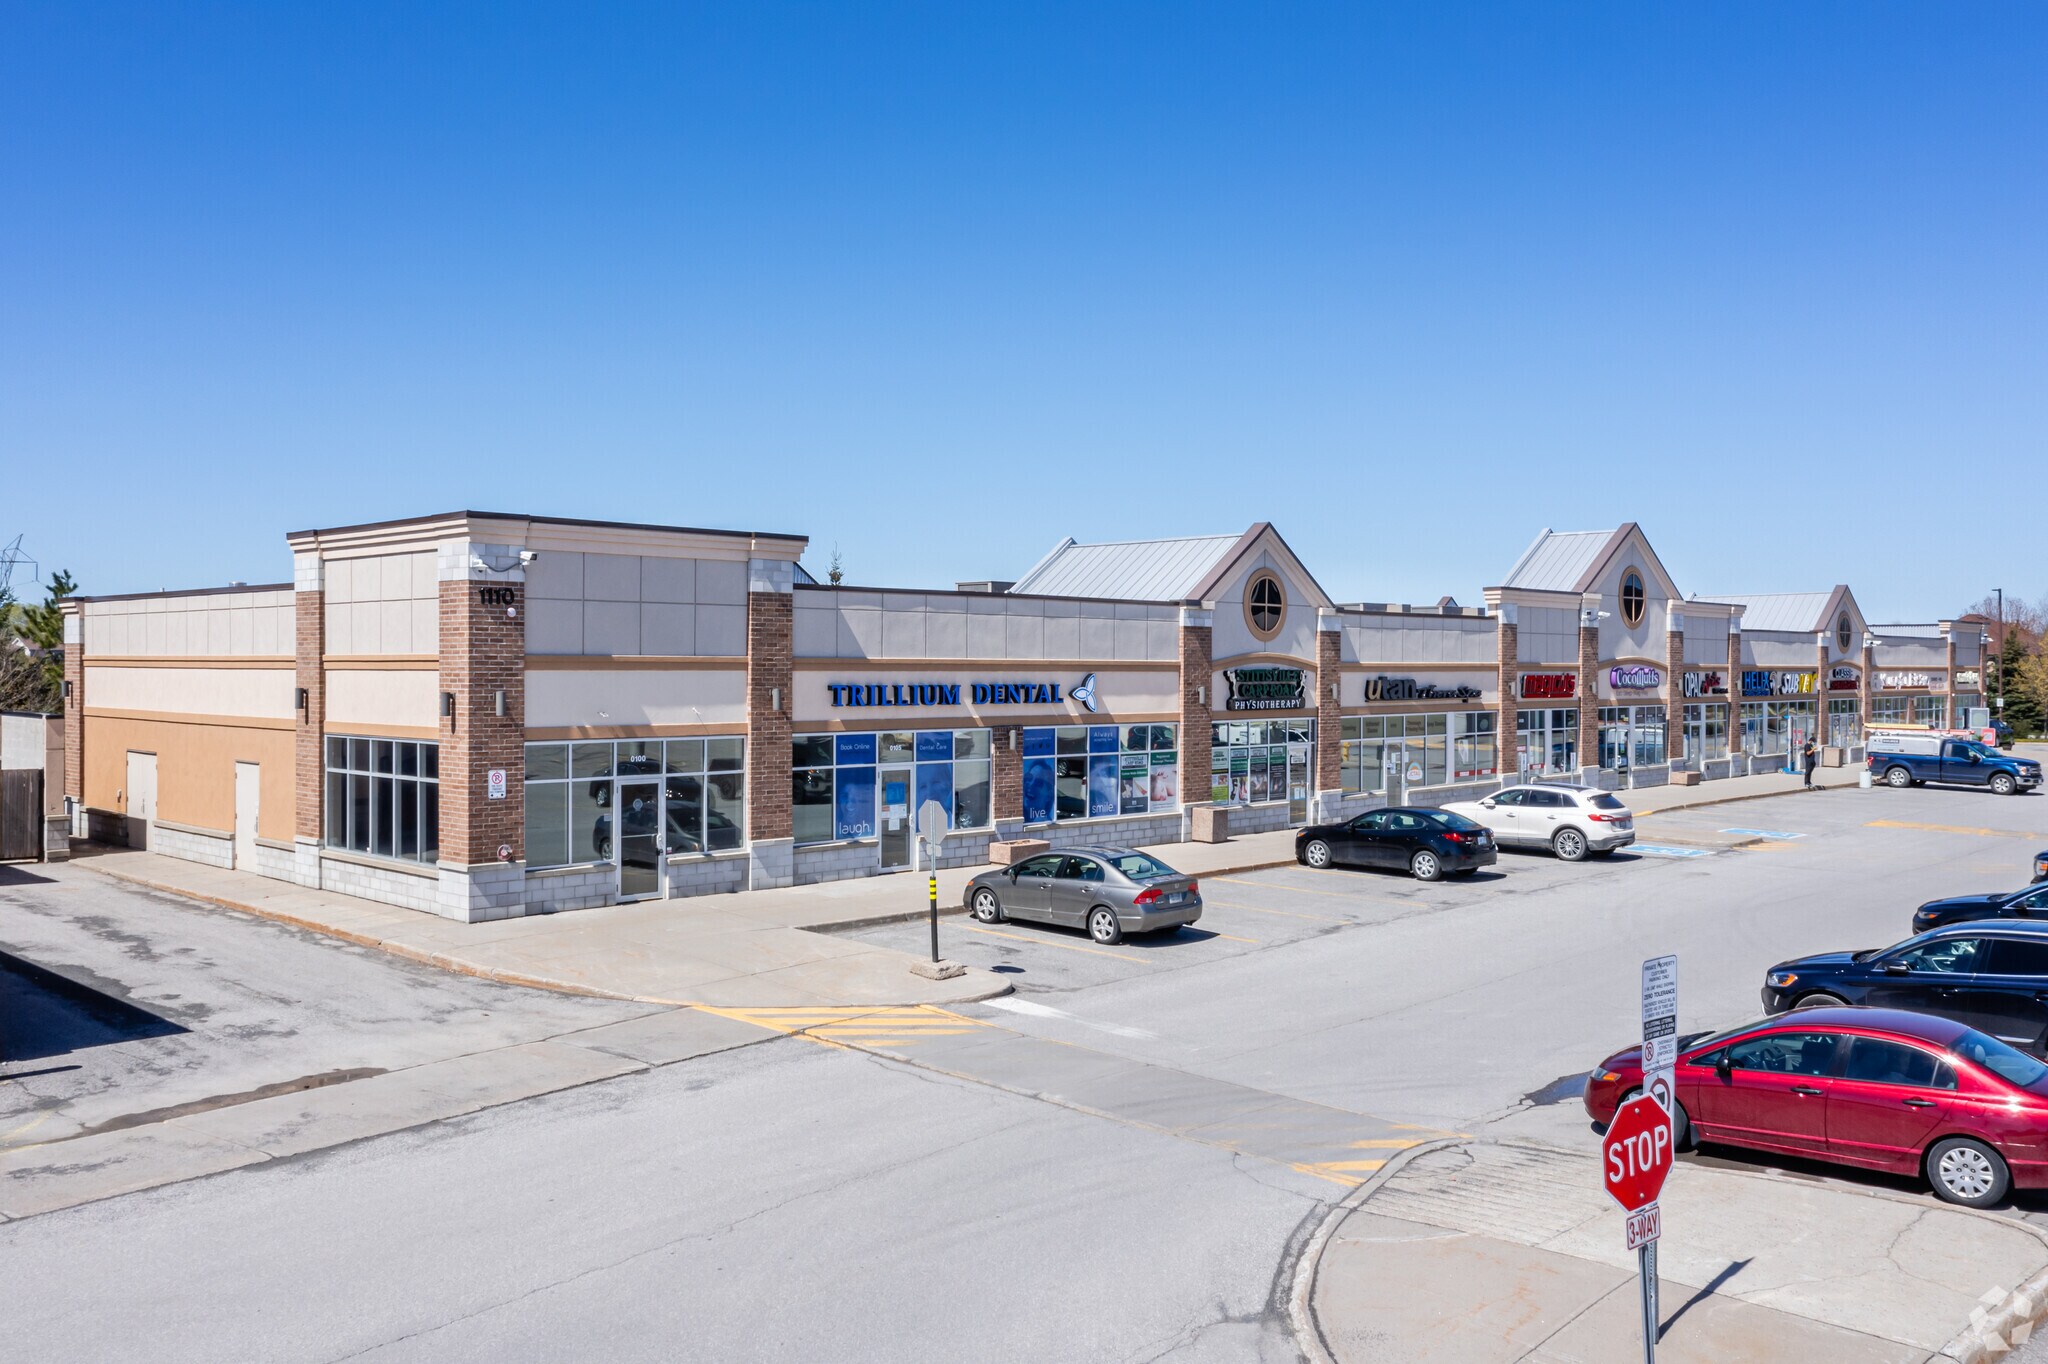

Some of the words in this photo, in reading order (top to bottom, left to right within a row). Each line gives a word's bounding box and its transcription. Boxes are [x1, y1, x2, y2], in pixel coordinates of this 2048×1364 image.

[479, 587, 515, 605] 1110
[1743, 671, 1770, 689] HELIX
[1782, 671, 1818, 694] SUBWAY
[828, 684, 961, 707] TRILLIUM
[971, 683, 1064, 705] DENTAL
[1235, 699, 1301, 710] PHYSIOTHERAPY
[630, 755, 647, 763] 0100
[1654, 988, 1675, 998] TOLERANCE
[1608, 1124, 1669, 1184] STOP
[1629, 1213, 1658, 1244] 3-WAY
